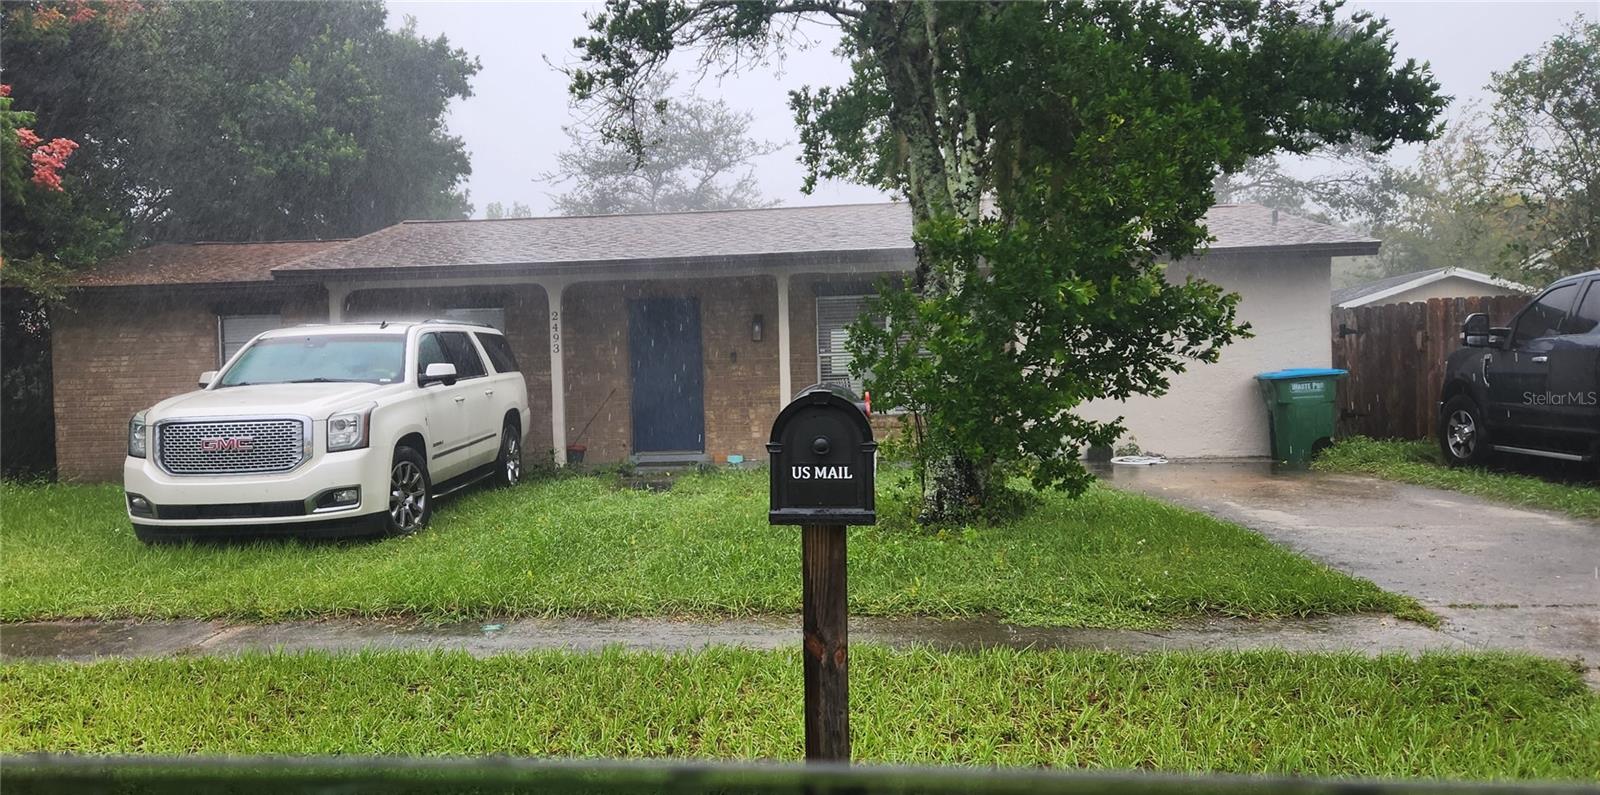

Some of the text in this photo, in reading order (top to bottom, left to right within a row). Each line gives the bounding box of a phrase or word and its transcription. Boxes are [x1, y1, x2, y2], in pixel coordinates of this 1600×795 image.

[551, 311, 560, 354] 2493
[201, 438, 254, 451] GMC
[791, 466, 853, 479] US MAIL
